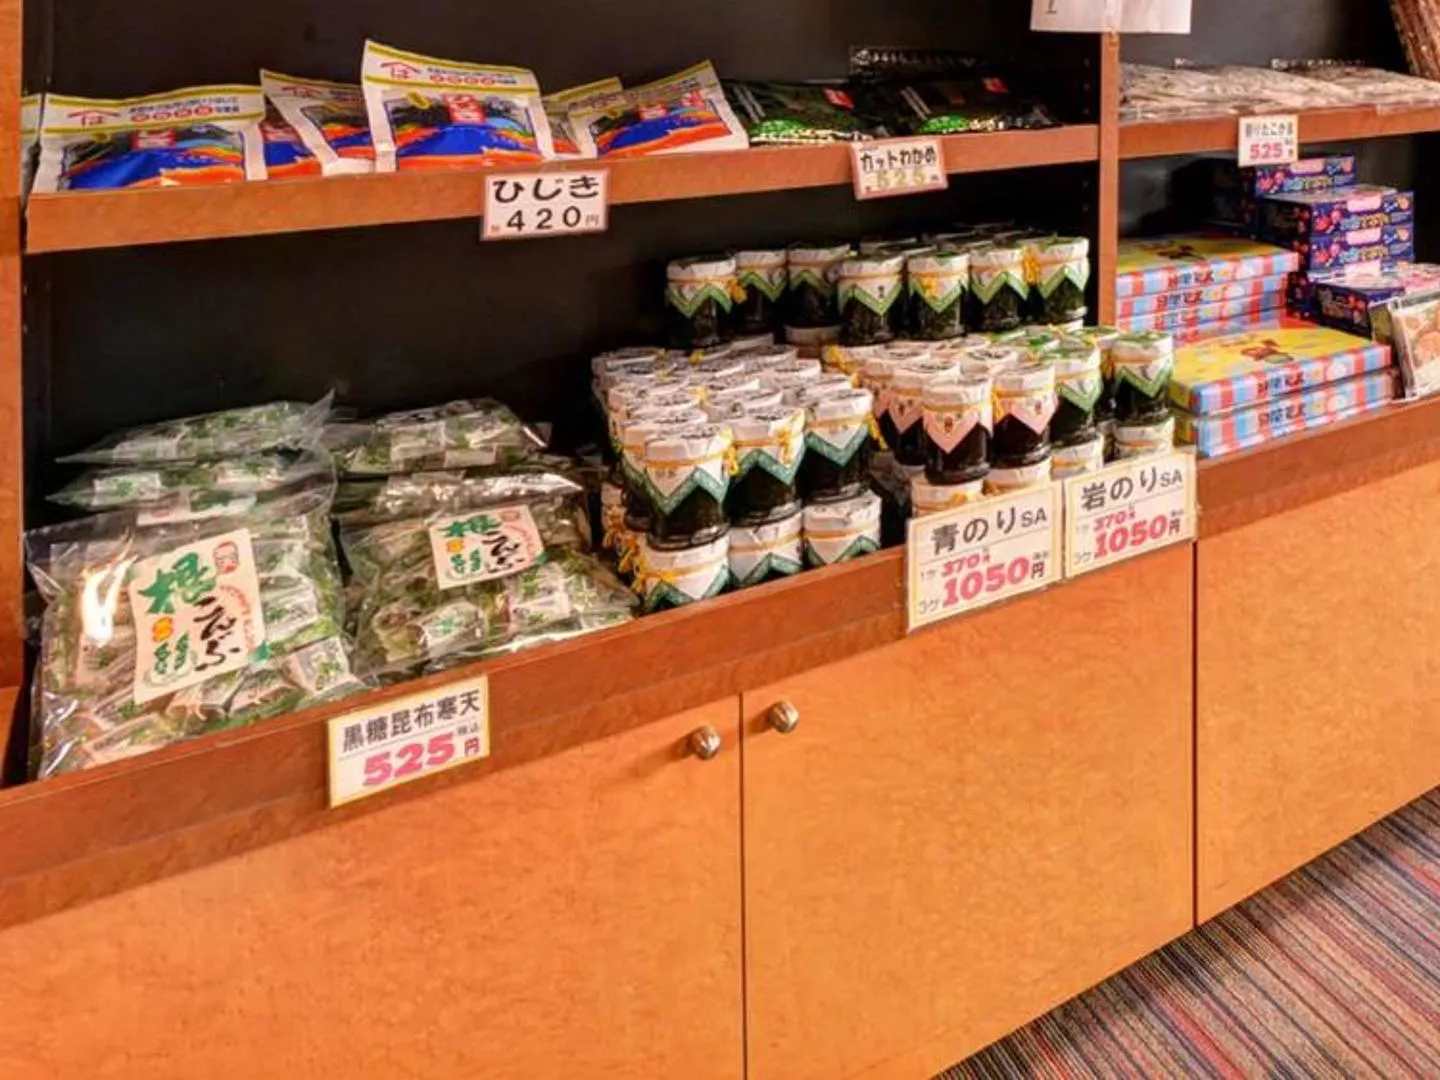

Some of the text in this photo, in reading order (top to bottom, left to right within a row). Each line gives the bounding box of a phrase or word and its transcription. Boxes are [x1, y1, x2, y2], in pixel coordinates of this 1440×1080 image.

[860, 145, 937, 172] カットわかめ
[492, 175, 600, 204] ひじき
[342, 689, 481, 754] 黒糖昆布寒天
